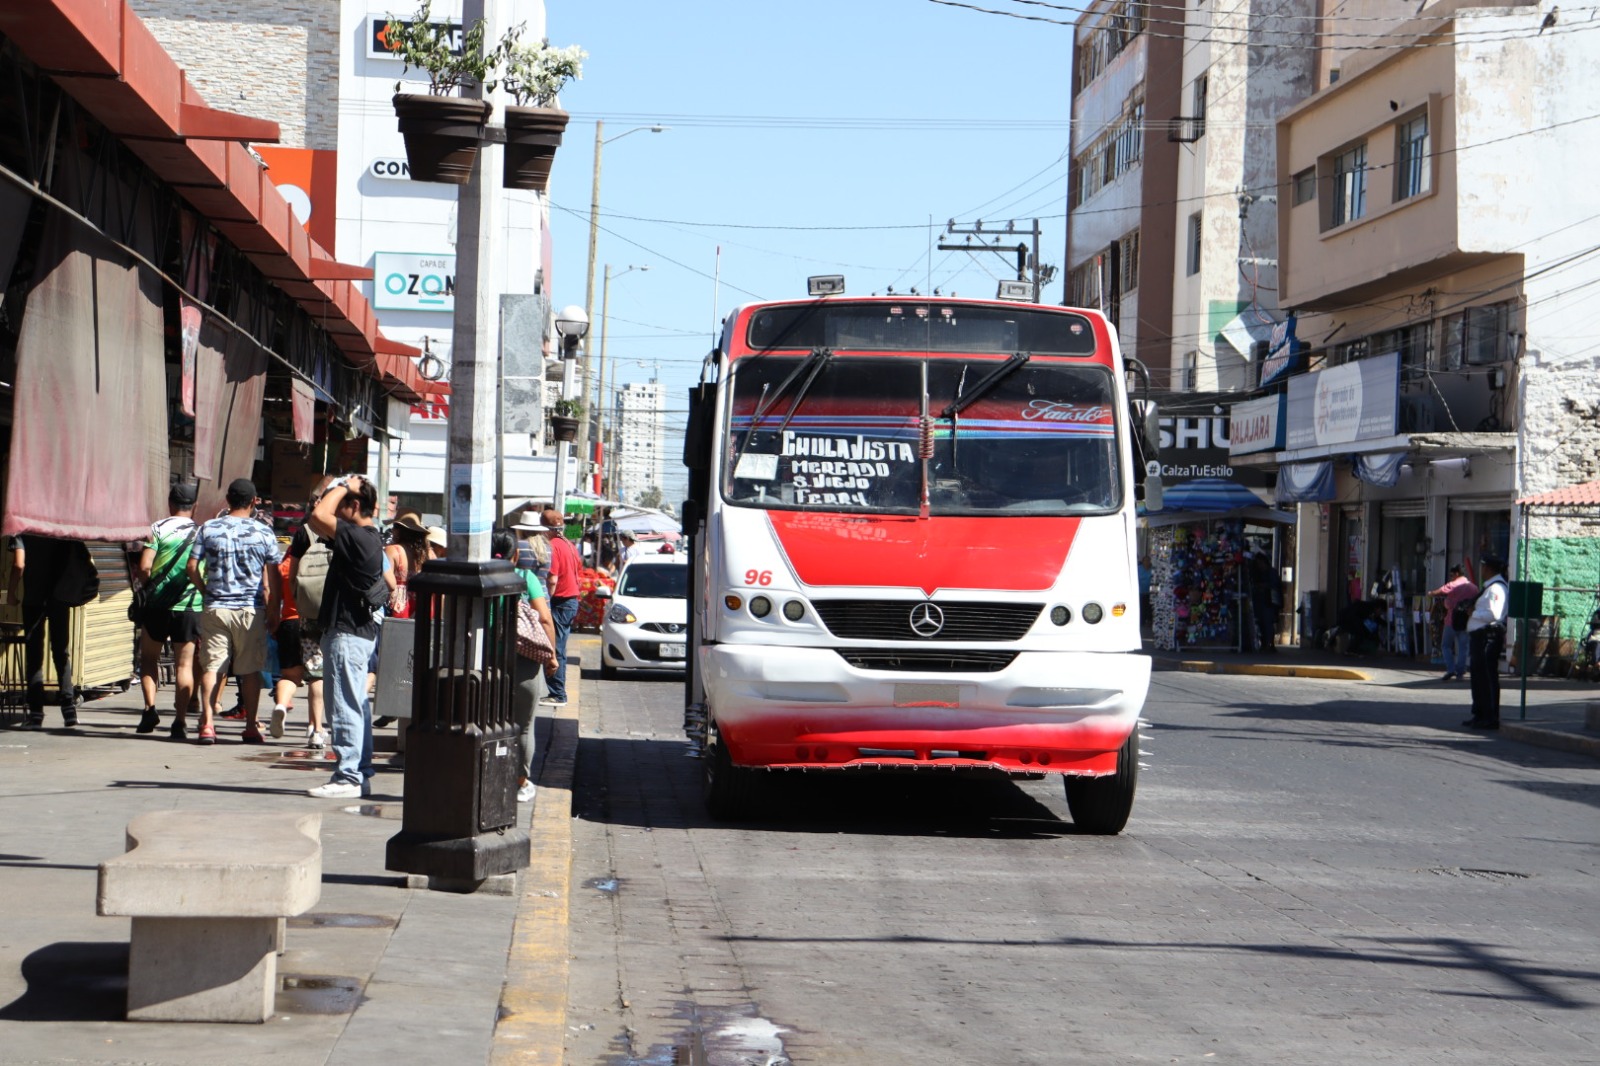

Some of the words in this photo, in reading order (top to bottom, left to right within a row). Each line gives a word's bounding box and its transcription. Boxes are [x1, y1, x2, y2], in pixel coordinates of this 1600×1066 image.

[419, 260, 437, 268] CAPA
[438, 260, 446, 269] DE
[1022, 399, 1112, 422] Fausto
[744, 568, 773, 586] 96
